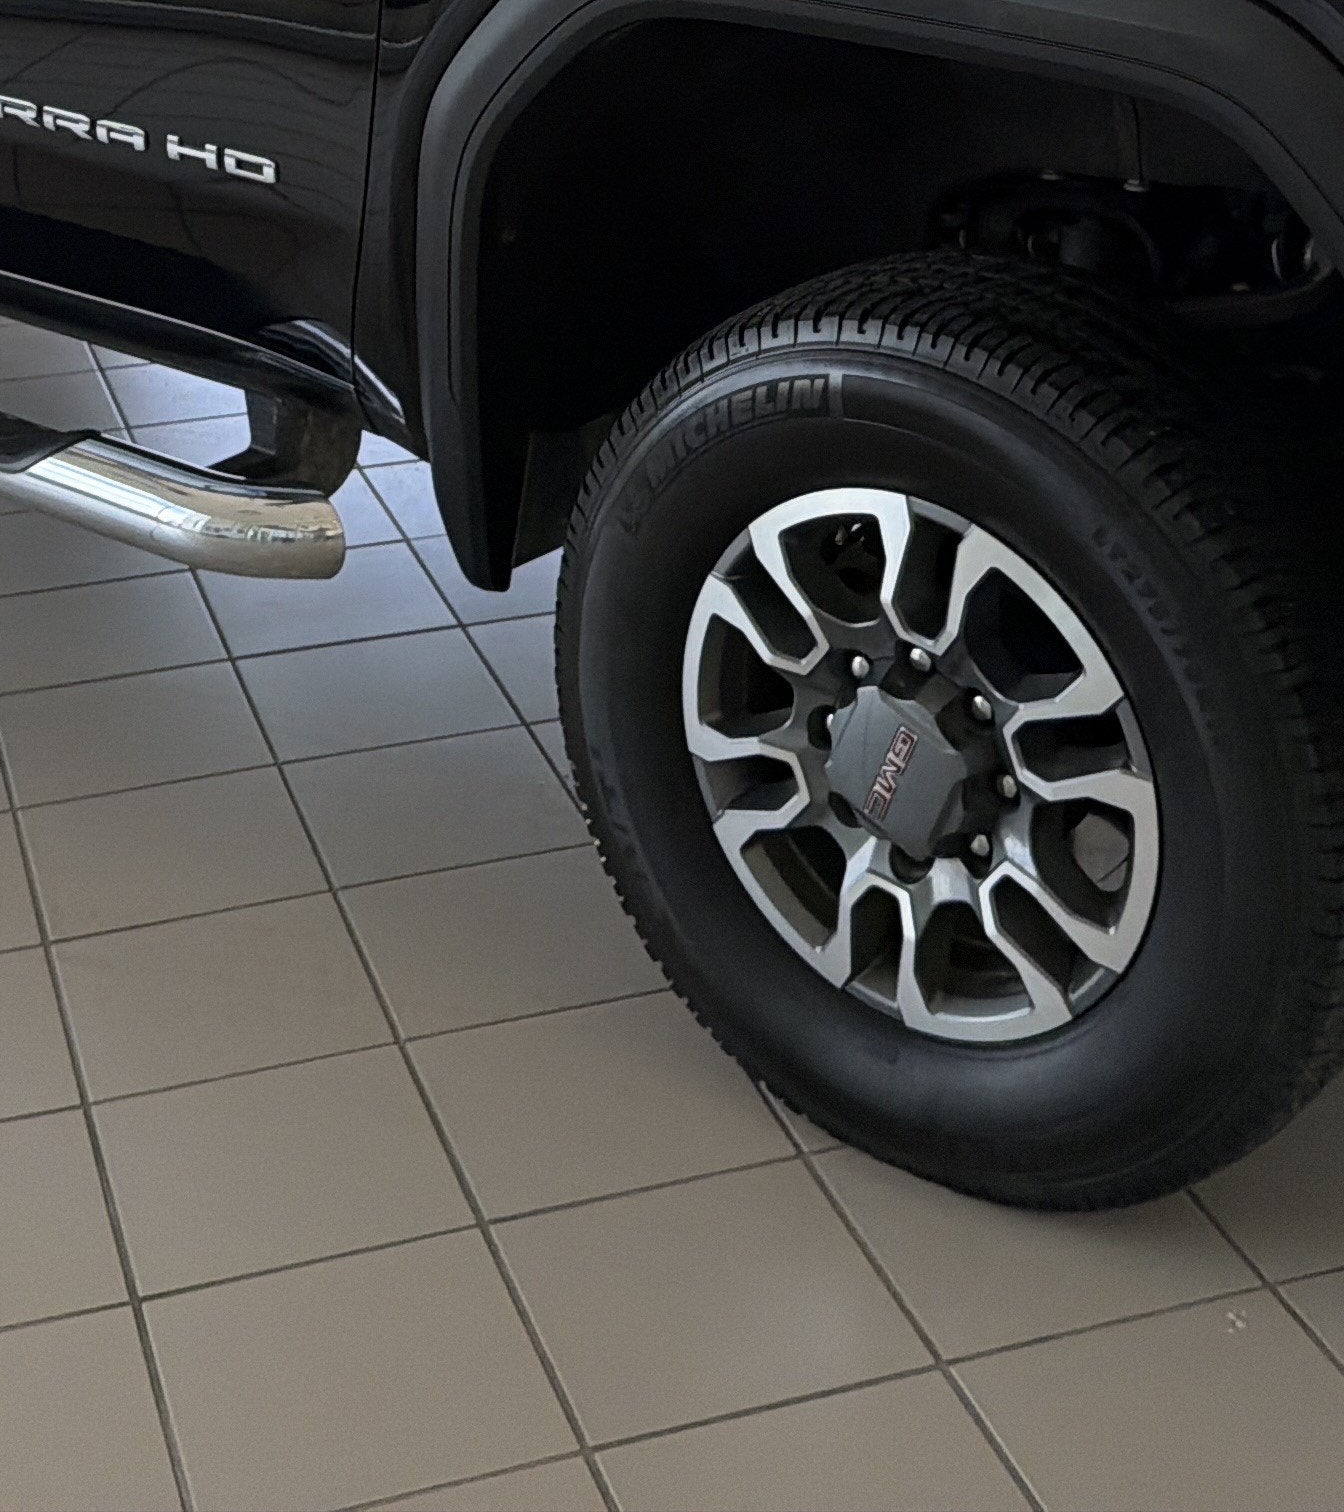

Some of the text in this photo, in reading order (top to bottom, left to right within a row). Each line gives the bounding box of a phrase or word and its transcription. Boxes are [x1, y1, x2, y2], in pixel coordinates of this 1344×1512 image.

[166, 134, 276, 184] HD
[646, 377, 827, 489] MICHELIN
[864, 726, 918, 822] GMC
